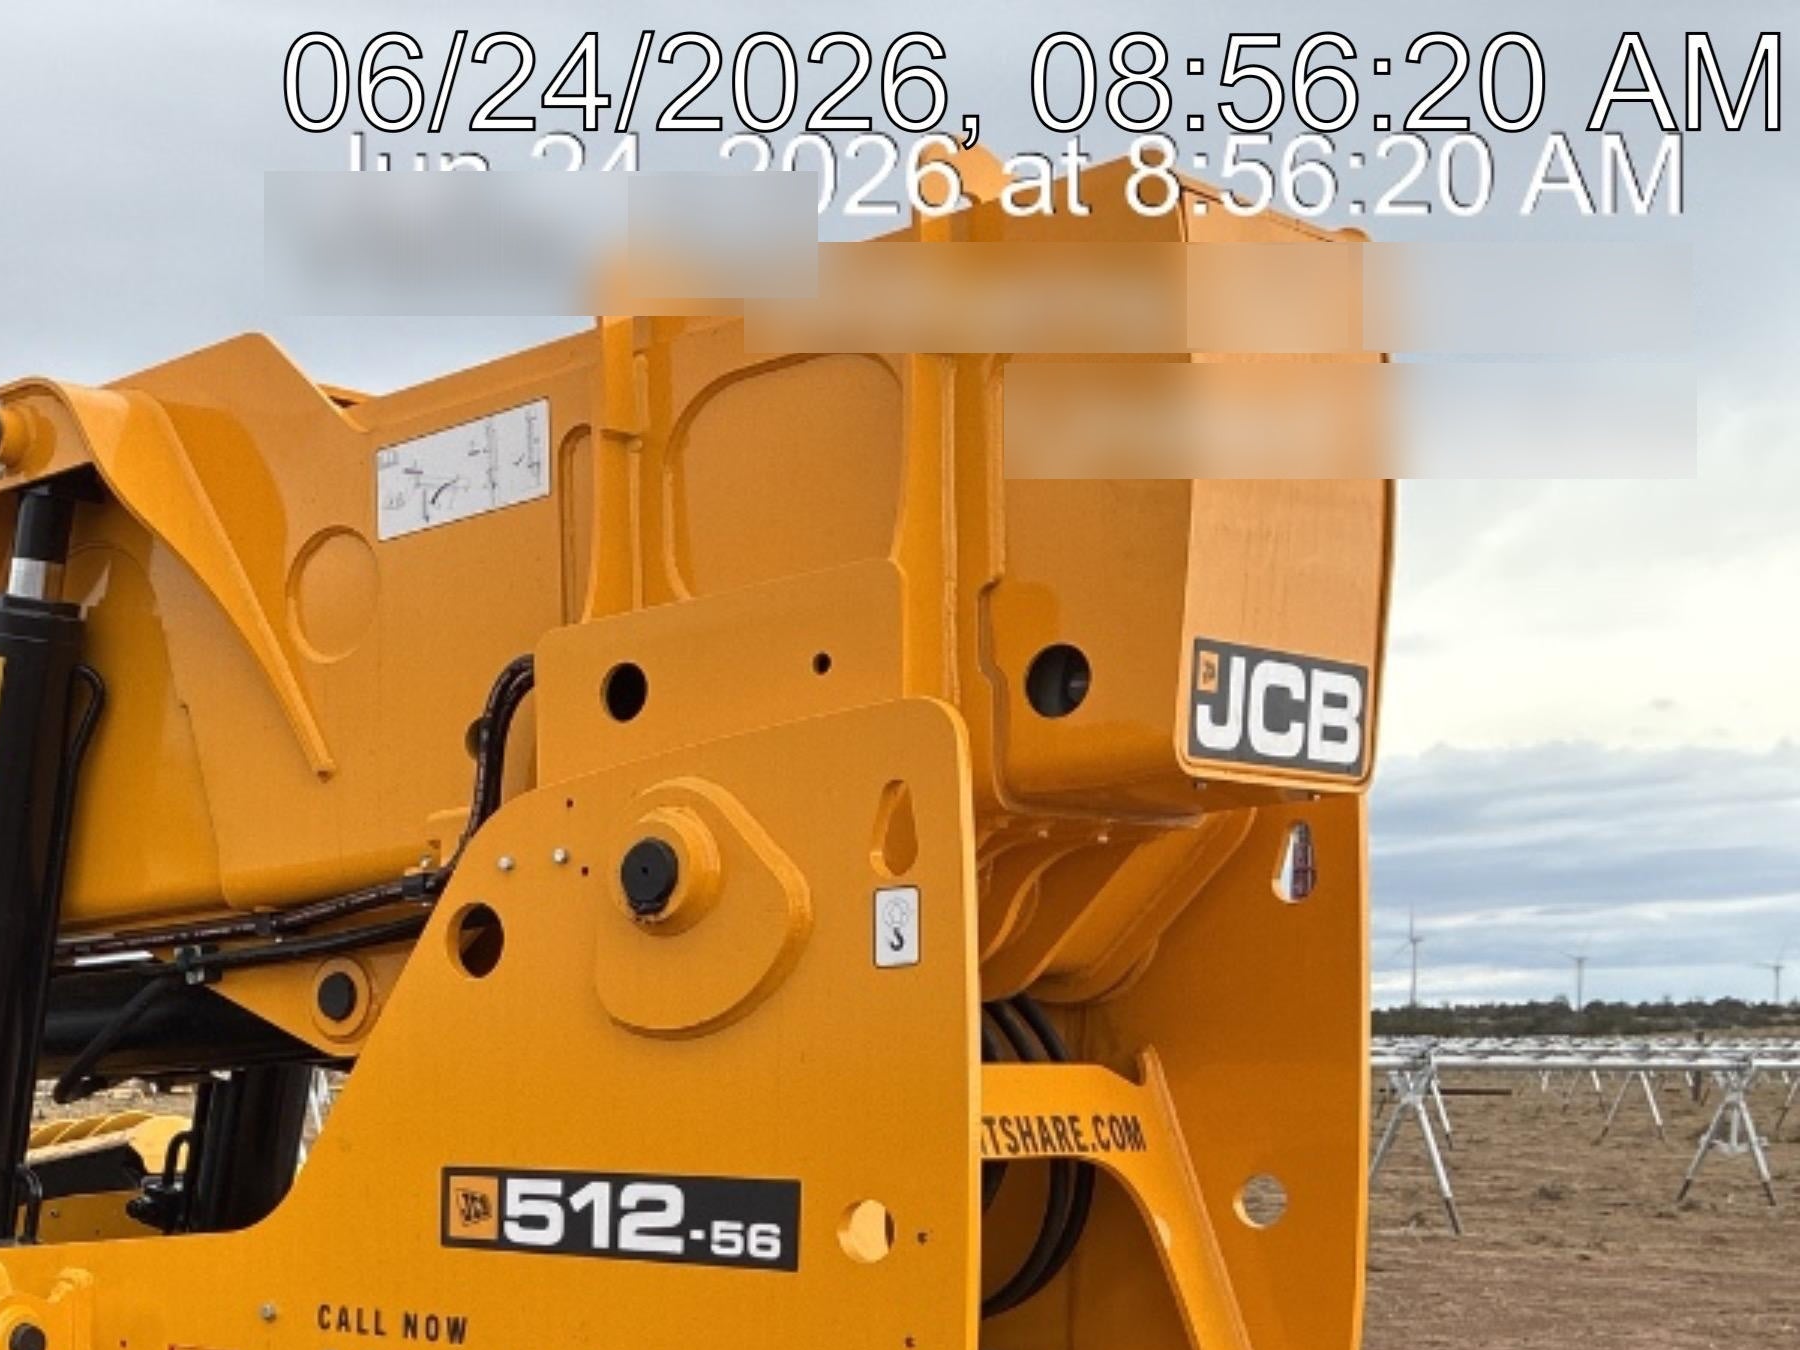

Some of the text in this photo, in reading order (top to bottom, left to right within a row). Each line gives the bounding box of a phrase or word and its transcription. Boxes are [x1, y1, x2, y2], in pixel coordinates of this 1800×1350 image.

[1196, 655, 1363, 764] JCB
[981, 1114, 1147, 1155] TSHARE.COM
[317, 1303, 468, 1345] CALL NOW
